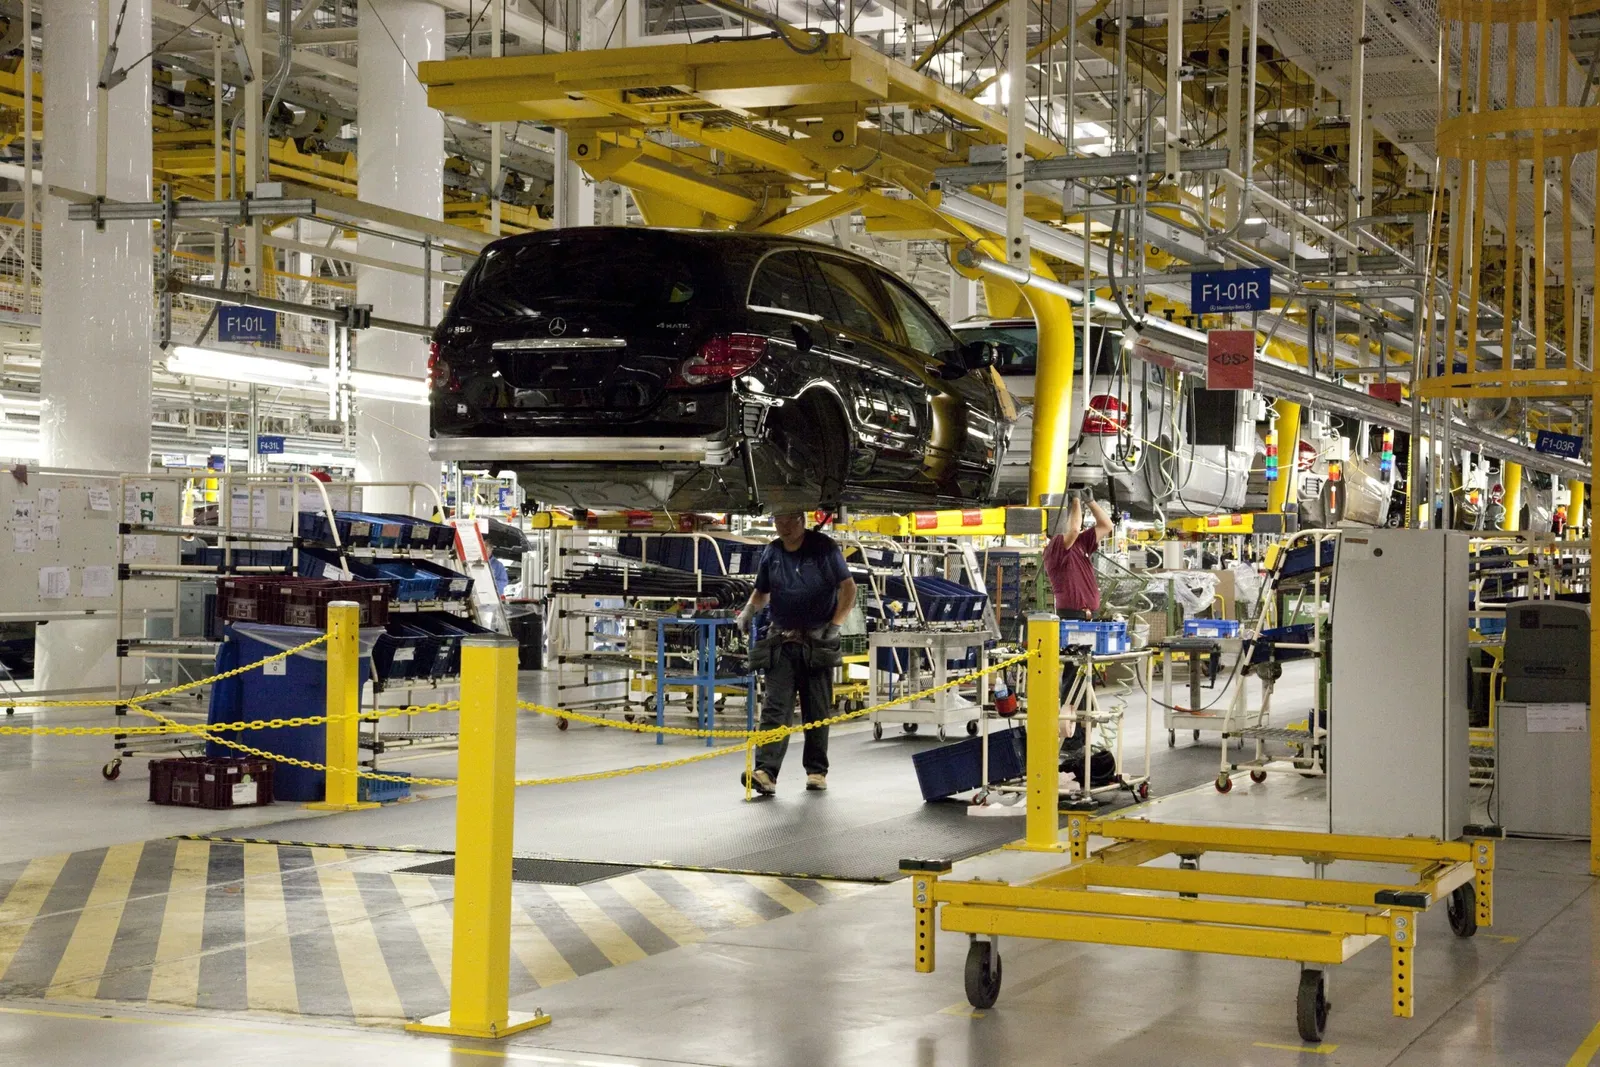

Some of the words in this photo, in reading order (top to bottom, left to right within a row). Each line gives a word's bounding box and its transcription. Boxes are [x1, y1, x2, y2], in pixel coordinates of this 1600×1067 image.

[1202, 281, 1260, 302] F1-01R
[227, 316, 267, 332] F1-01L
[260, 441, 280, 450] F4-31L
[1541, 436, 1576, 453] F1-03R
